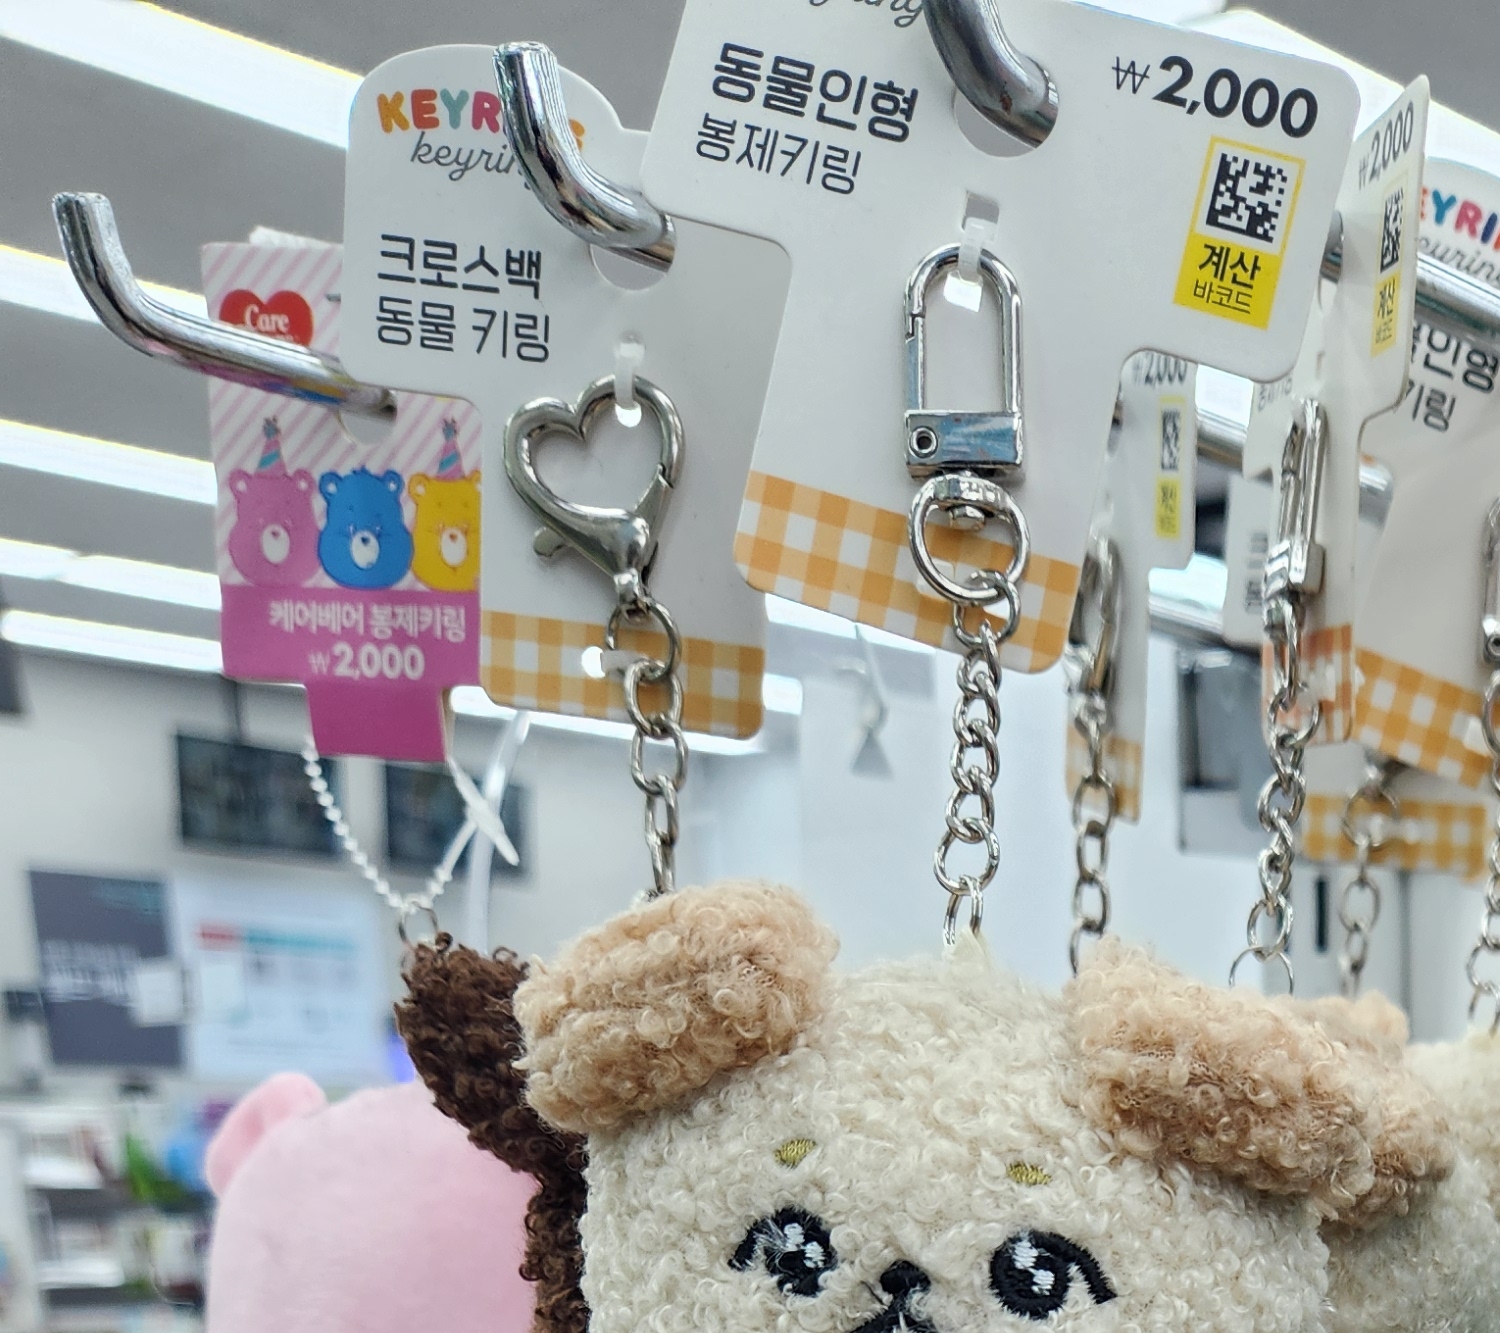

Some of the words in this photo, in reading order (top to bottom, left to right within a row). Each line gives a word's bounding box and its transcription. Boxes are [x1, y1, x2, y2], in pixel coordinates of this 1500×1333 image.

[377, 89, 586, 151] KEYR
[712, 42, 919, 143] 동물인형
[1111, 55, 1319, 139] ₩2,000
[696, 112, 862, 195] 봉제키링
[377, 233, 542, 300] 크로스백
[1193, 279, 1253, 314] 바코드
[1198, 242, 1261, 289] 계산
[244, 303, 289, 333] Care
[376, 295, 457, 352] 동물
[472, 307, 550, 363] 키링
[269, 599, 364, 636] 케어베어
[370, 603, 466, 643] 봉제키링
[308, 641, 425, 681] ₩2,000
